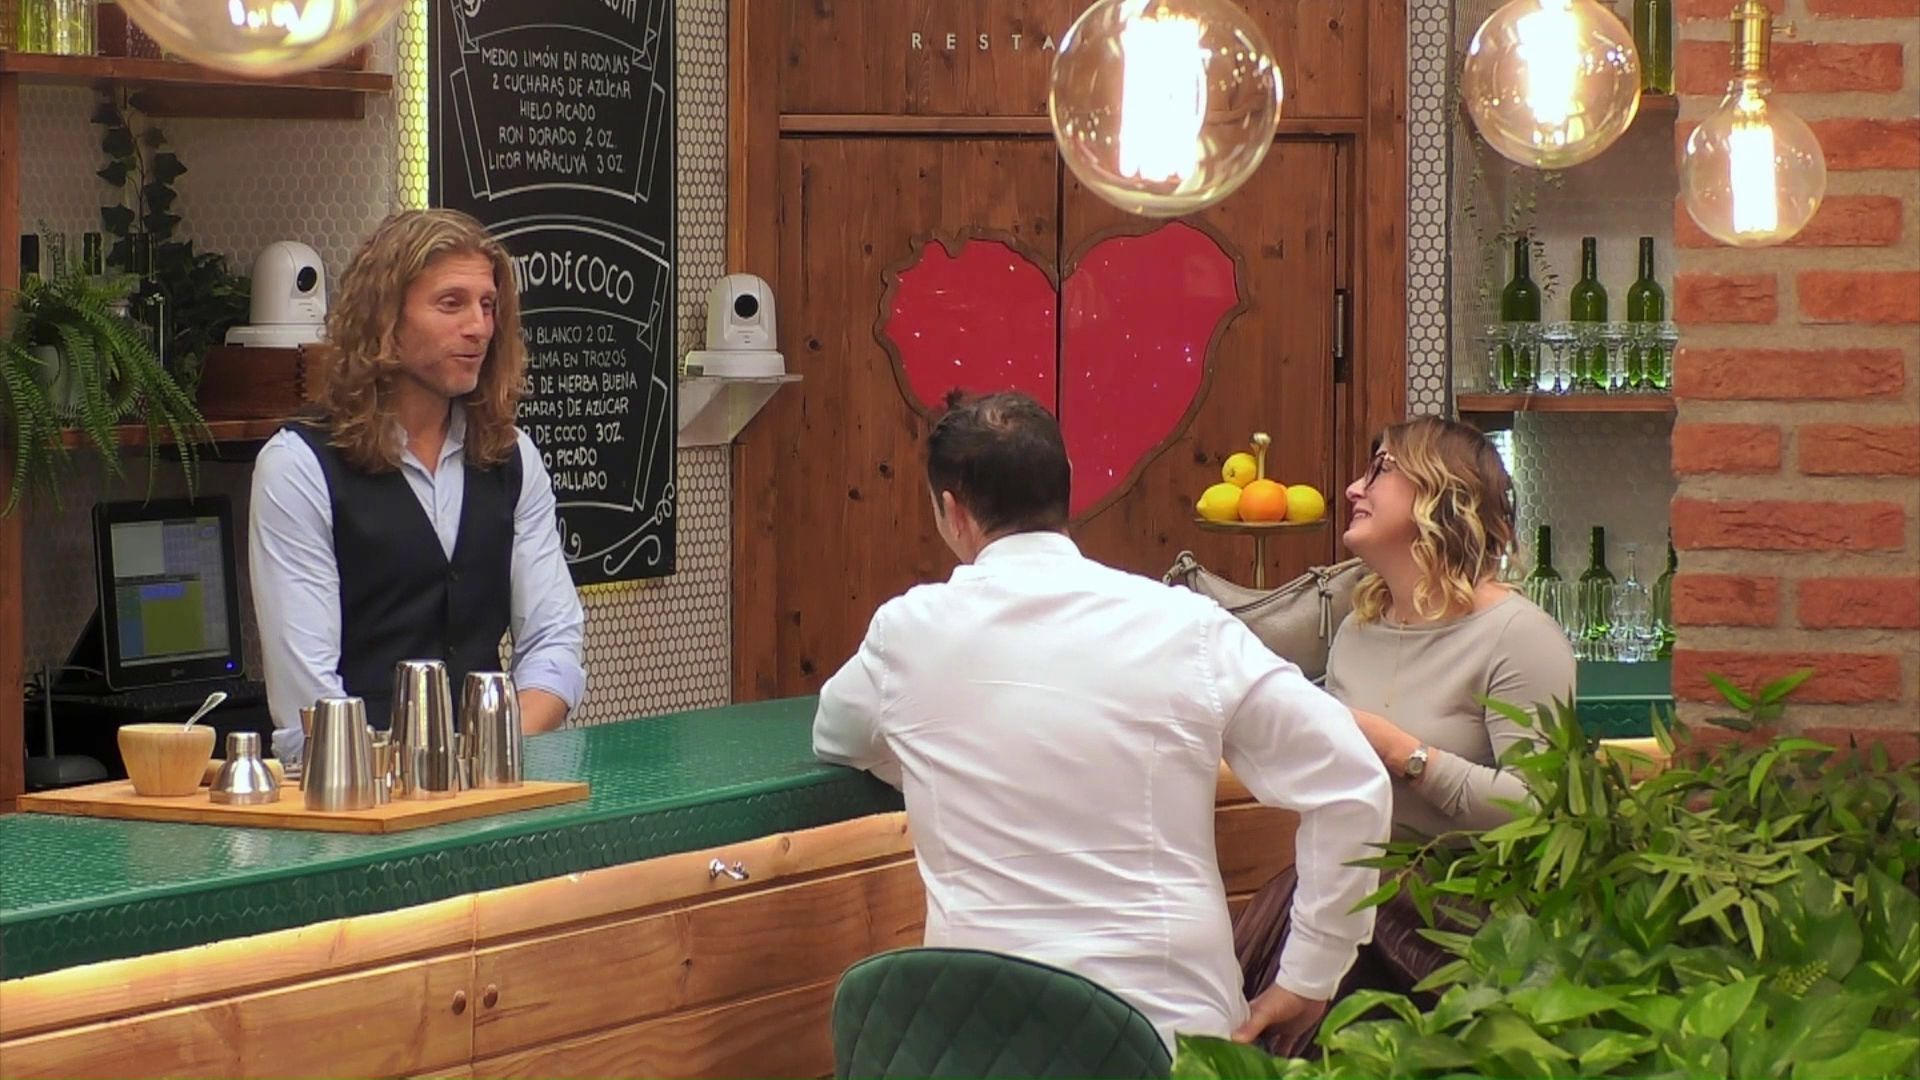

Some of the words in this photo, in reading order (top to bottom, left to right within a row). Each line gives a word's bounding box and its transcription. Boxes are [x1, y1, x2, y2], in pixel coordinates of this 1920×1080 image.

[482, 47, 518, 68] MEDIO
[524, 45, 558, 69] LIMÓN
[563, 51, 577, 71] EN
[581, 52, 630, 75] RODAJAS
[492, 72, 499, 90] 2
[504, 73, 565, 97] CUCHARAS
[568, 77, 583, 97] DE
[587, 73, 631, 99] AZÚCAR
[520, 99, 552, 121] HIELO
[556, 101, 596, 122] PICADO
[499, 126, 523, 145] RON
[529, 126, 577, 146] DORADO
[585, 126, 594, 147] 2
[488, 149, 521, 170] LICOR
[526, 147, 588, 175] MARACUYÁ
[597, 154, 604, 174] 3
[537, 326, 582, 344] BLANCO
[586, 325, 593, 343] 2
[531, 350, 561, 369] LIMA
[563, 352, 578, 368] EN
[582, 348, 627, 368] TROZOS
[540, 375, 554, 394] DE
[602, 371, 638, 392] BUENA
[567, 397, 582, 417] DE
[585, 393, 629, 417] AZÚCAR
[535, 424, 552, 445] DE
[554, 424, 588, 442] COCO
[556, 446, 598, 467] PICADO
[553, 470, 608, 491] RALLADO
